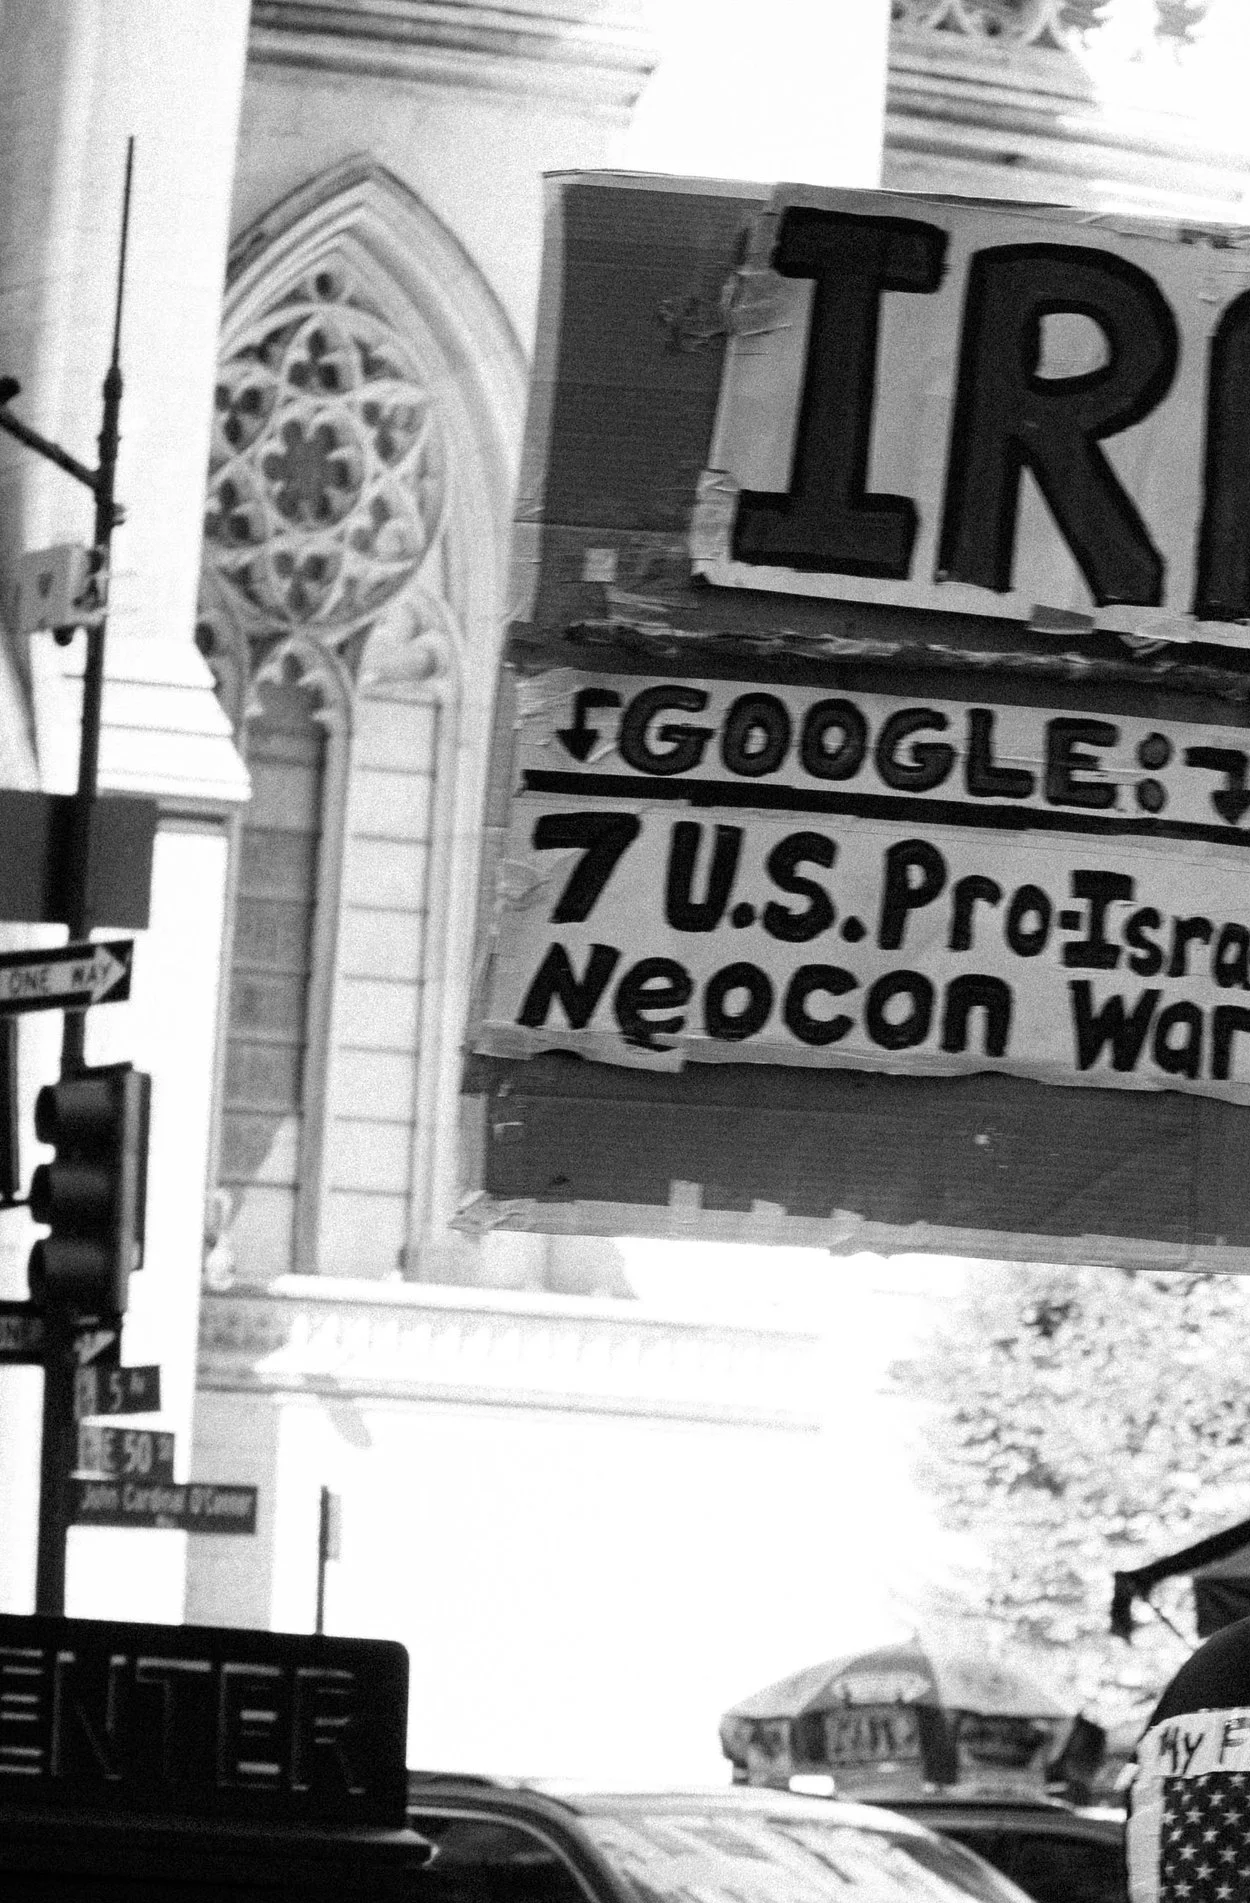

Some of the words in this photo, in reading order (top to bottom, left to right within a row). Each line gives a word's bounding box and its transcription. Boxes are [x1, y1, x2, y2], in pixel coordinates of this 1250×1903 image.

[532, 812, 641, 924] 7
[9, 965, 51, 995] ONE
[71, 962, 112, 988] WAY
[516, 942, 1013, 1056] Neocon
[124, 1431, 153, 1475] 50
